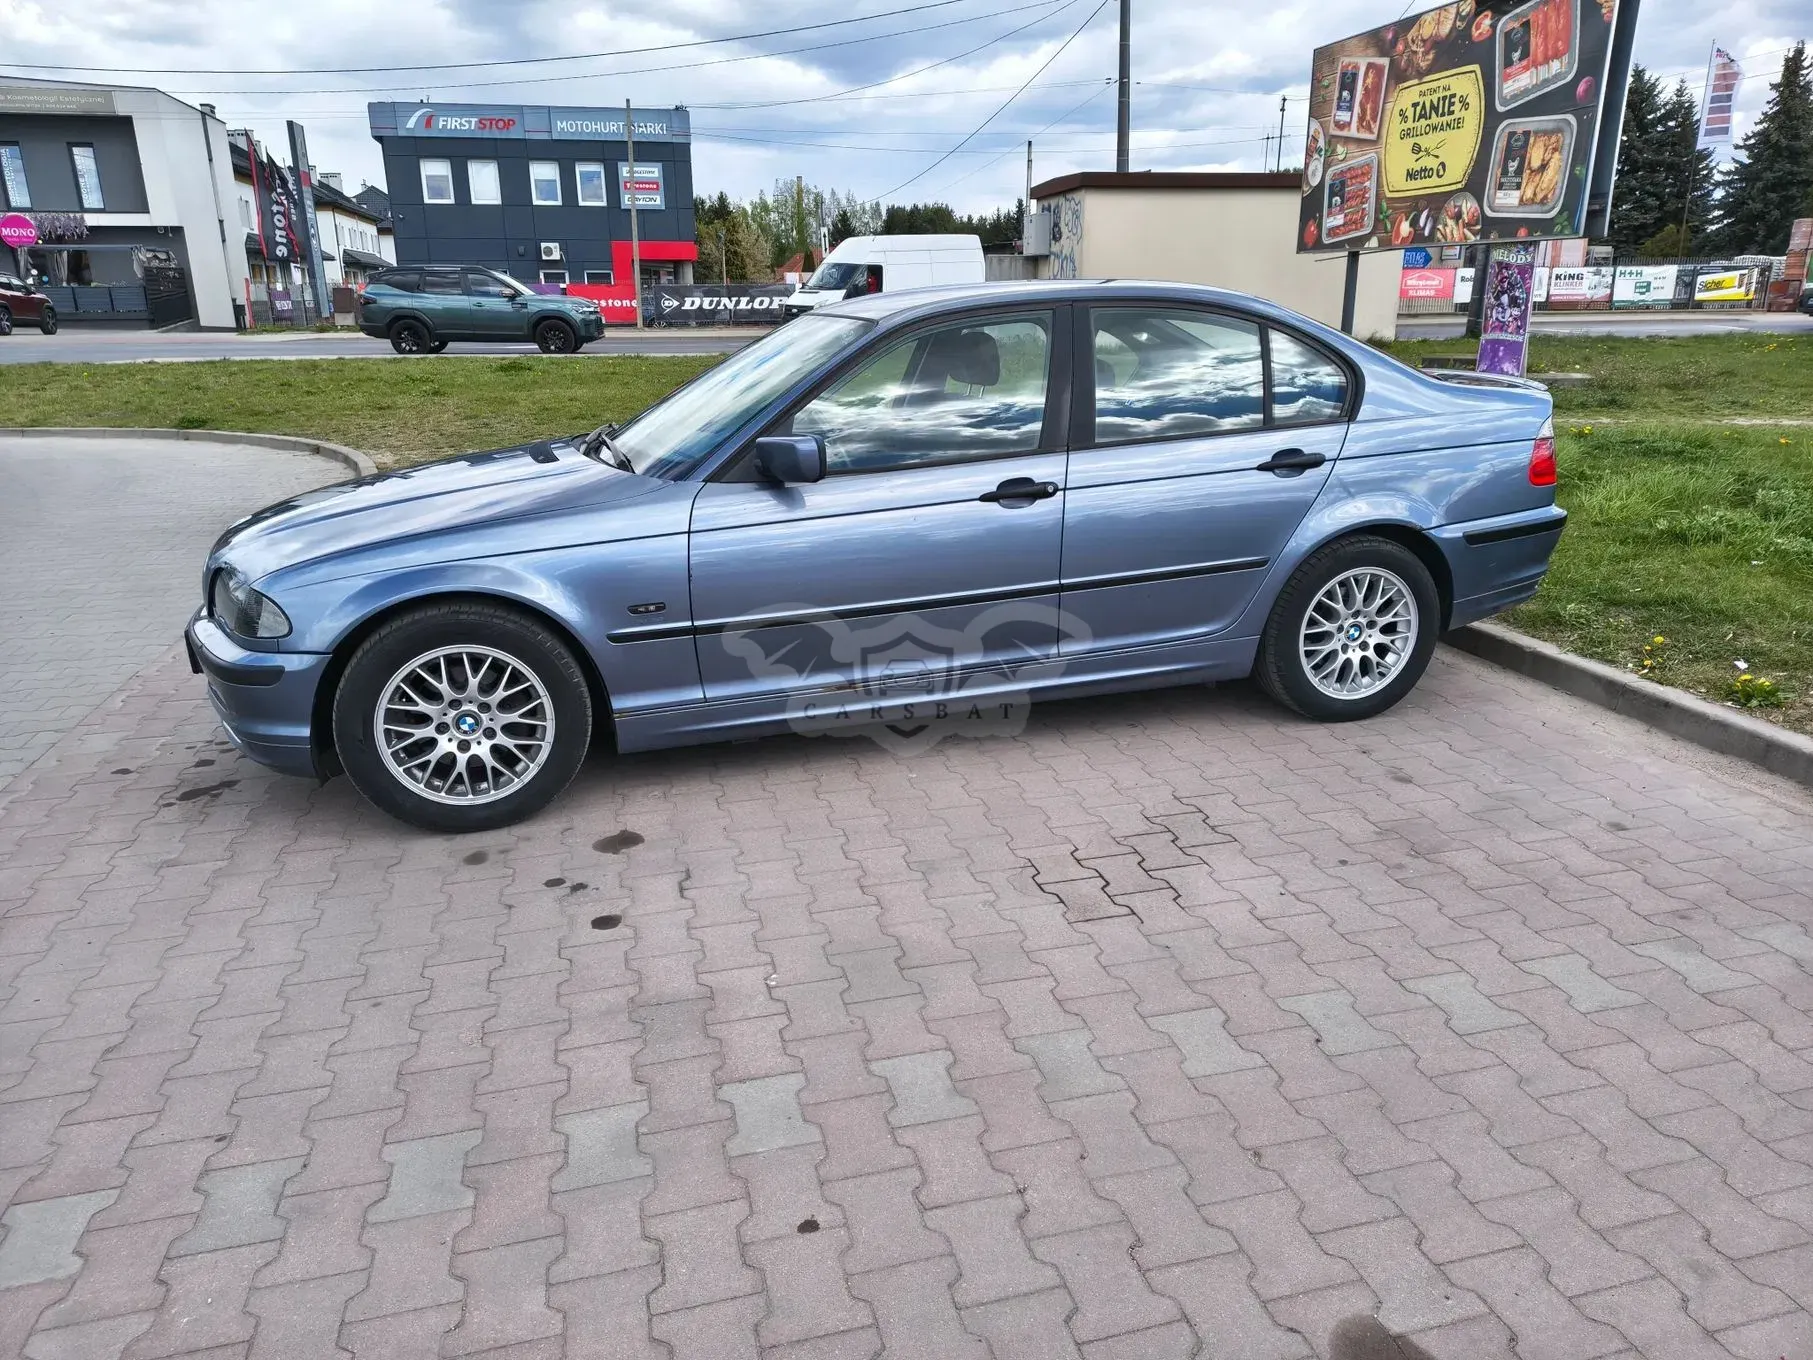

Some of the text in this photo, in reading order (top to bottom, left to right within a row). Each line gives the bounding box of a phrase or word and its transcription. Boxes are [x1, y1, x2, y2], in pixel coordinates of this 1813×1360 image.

[1419, 84, 1451, 98] PATENT NA
[1411, 93, 1456, 123] TANIE
[557, 121, 625, 133] MOTOHURT
[1400, 117, 1465, 140] GRILLOWANIE!
[1405, 165, 1434, 182] Netto
[1, 227, 36, 237] MONO
[1492, 249, 1534, 263] MELODY
[1698, 279, 1725, 291] Sicher
[681, 296, 788, 310] DUNLOP
